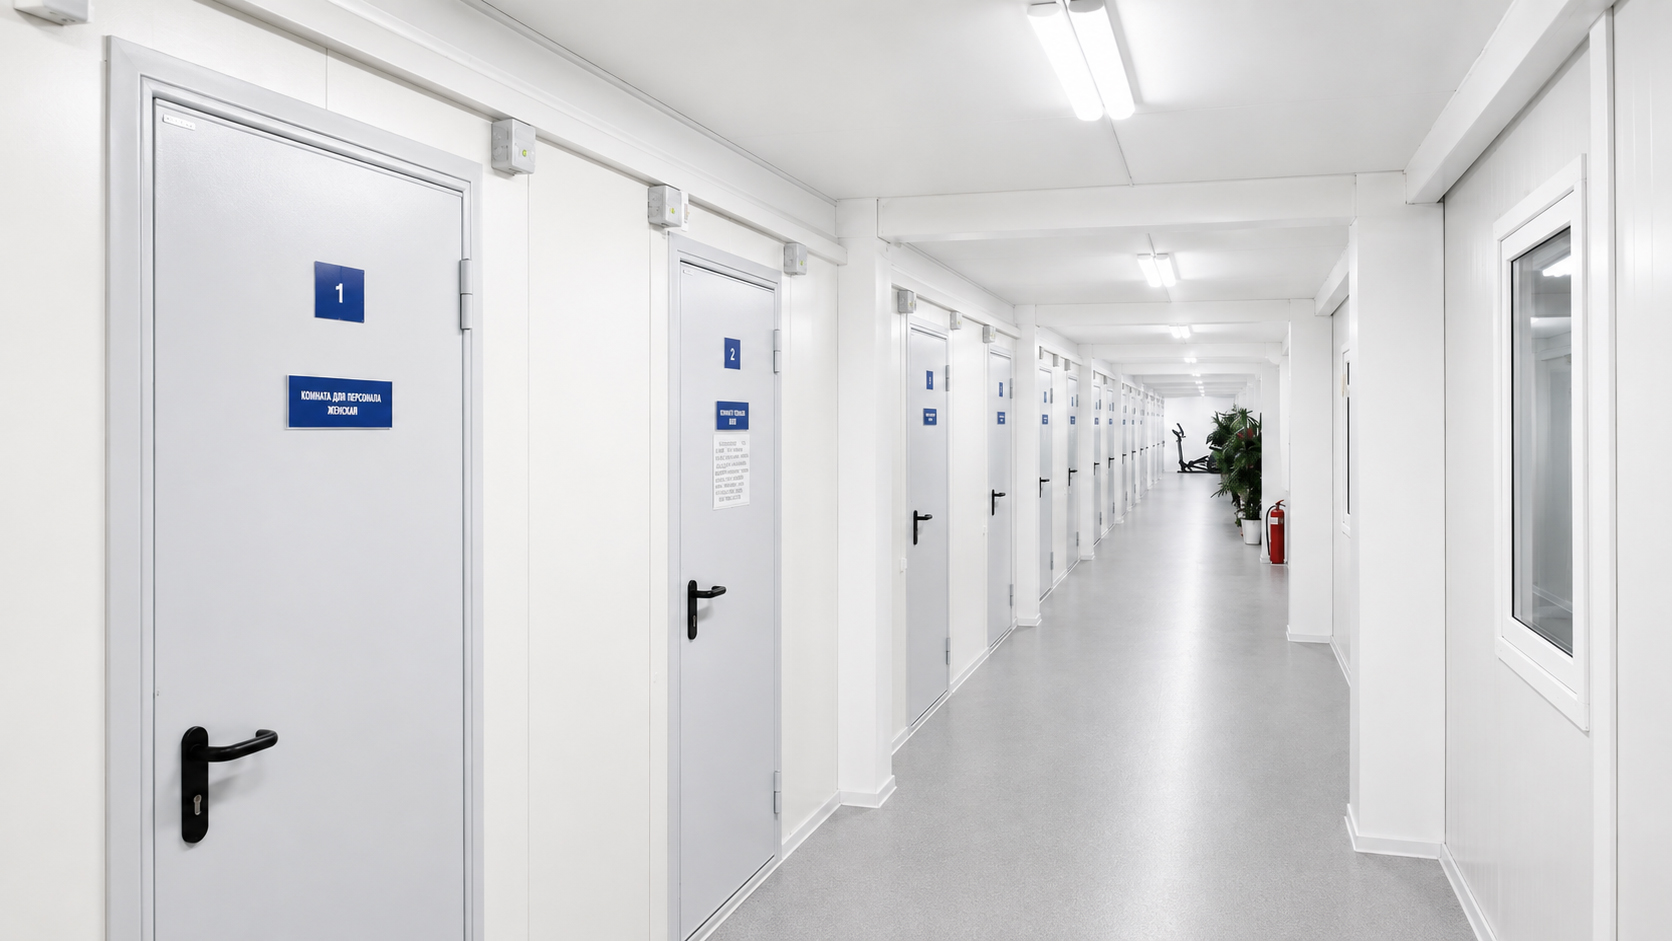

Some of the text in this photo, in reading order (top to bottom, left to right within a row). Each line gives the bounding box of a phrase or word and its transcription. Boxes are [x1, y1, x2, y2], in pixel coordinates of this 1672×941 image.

[335, 282, 343, 303] 1
[730, 347, 736, 361] 2
[300, 390, 332, 401] КОМНАТА
[347, 392, 382, 403] ПЕРСОНАЛА
